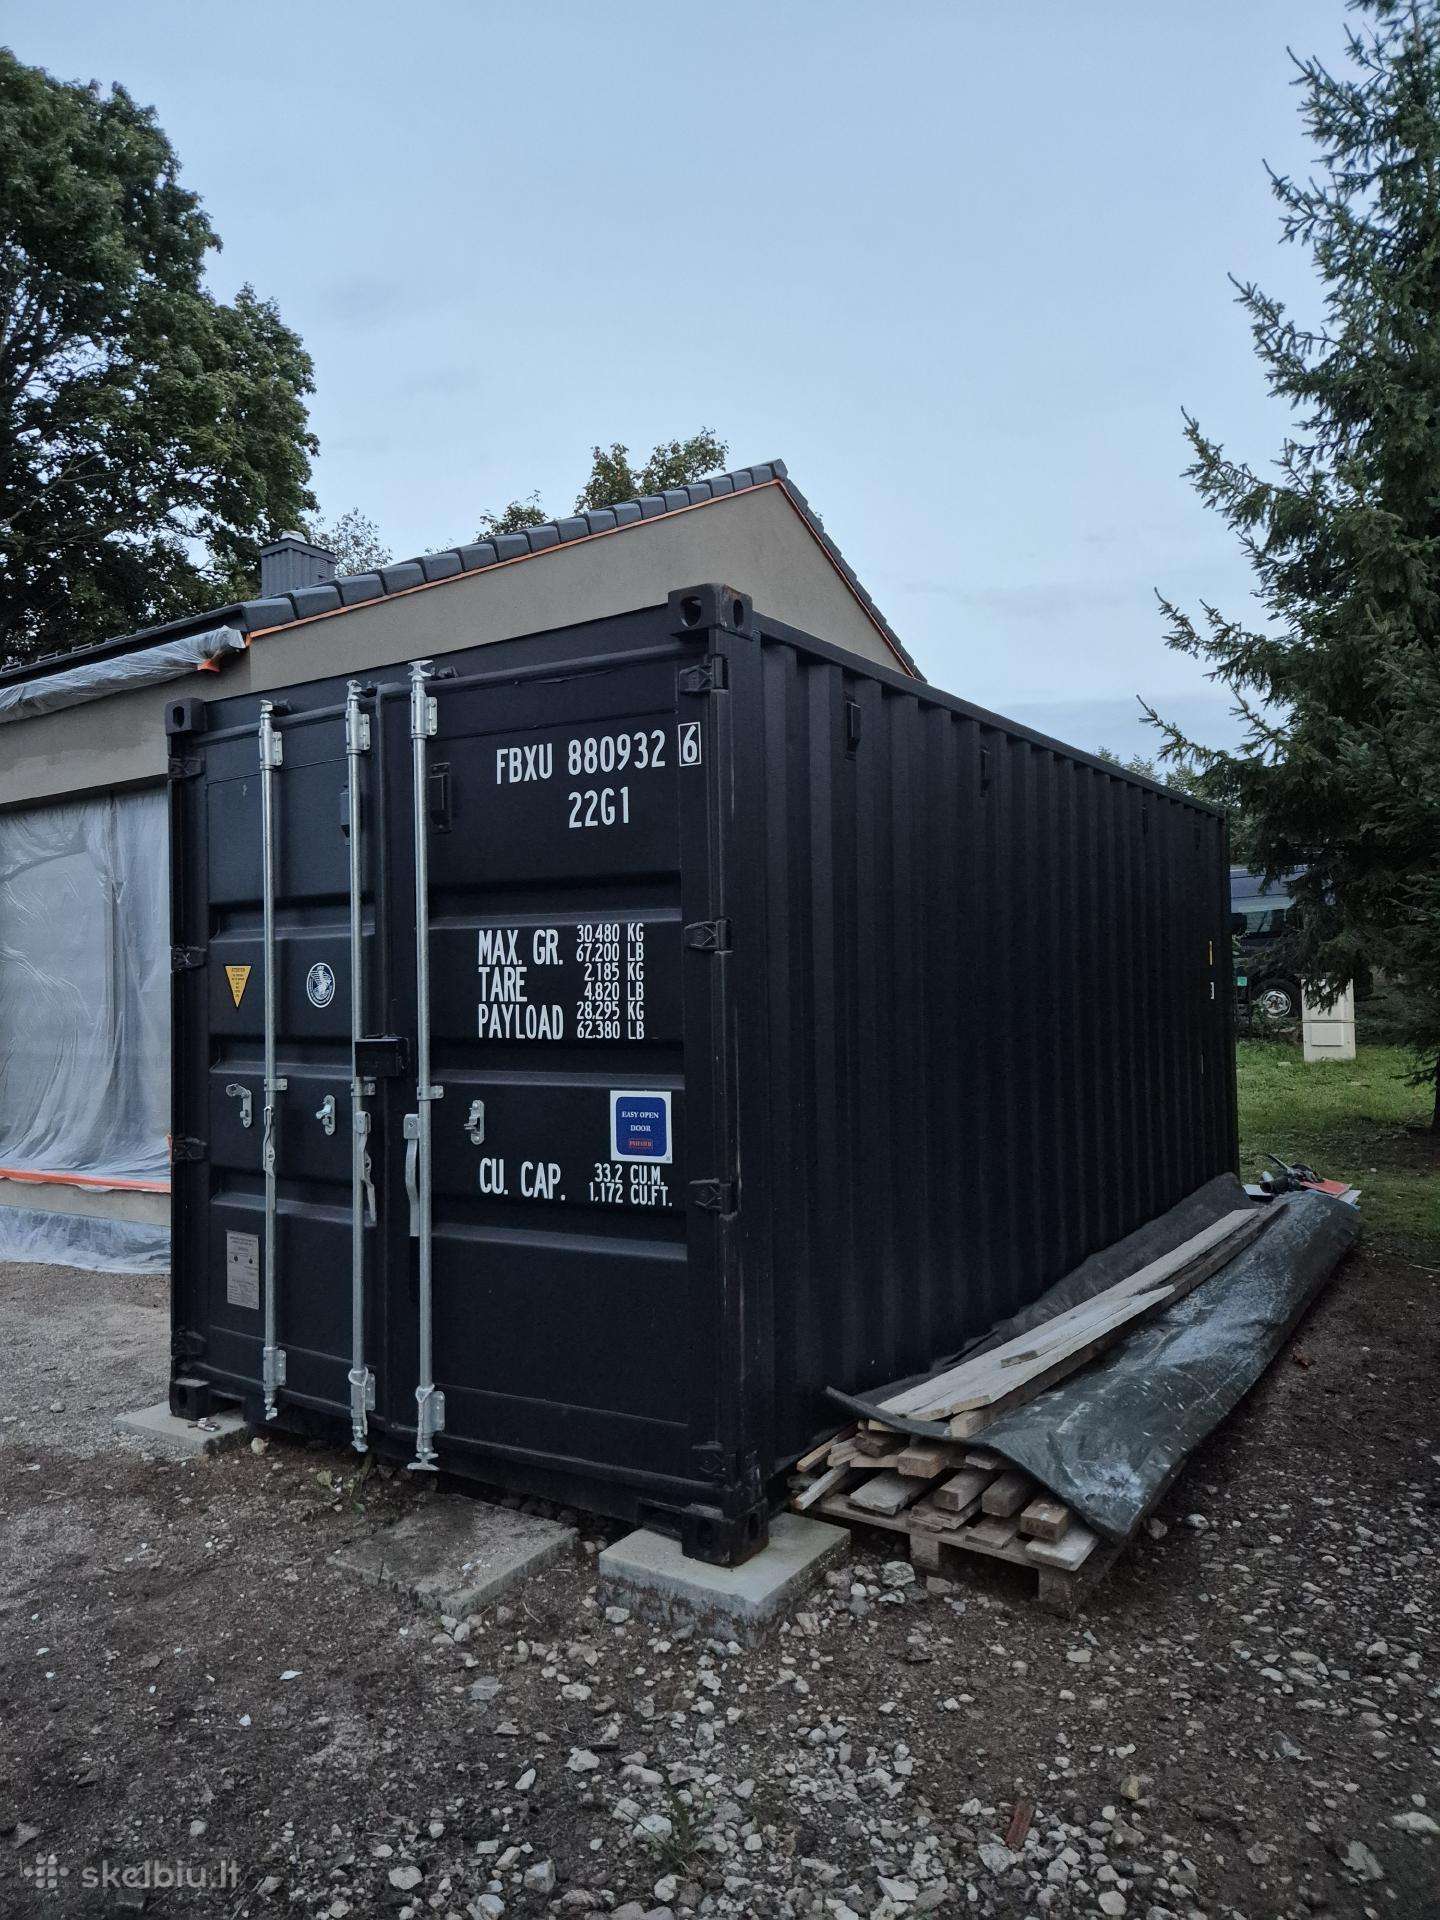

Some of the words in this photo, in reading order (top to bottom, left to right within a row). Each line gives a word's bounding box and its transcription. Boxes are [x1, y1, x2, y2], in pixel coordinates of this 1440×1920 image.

[496, 742, 553, 784] FBXU
[567, 729, 666, 776] 880932
[682, 725, 698, 763] 6
[568, 786, 629, 828] 22G1
[478, 929, 523, 966] MAX.
[533, 929, 564, 965] GR.
[627, 922, 644, 942] KG
[627, 943, 644, 962] LB
[478, 966, 527, 1002] TARE
[627, 962, 645, 981] KG
[627, 982, 645, 1001] LB
[478, 1003, 564, 1040] PAYLOAD
[627, 1001, 645, 1021] KG
[627, 1021, 645, 1040] LB
[621, 1110, 639, 1119] EASY
[639, 1111, 660, 1119] OPEN
[630, 1124, 652, 1132] DOOR
[479, 1157, 509, 1195] CU.
[520, 1161, 566, 1201] CAP.
[594, 1162, 623, 1184] 33.2
[629, 1164, 665, 1186] CU.M.
[630, 1184, 673, 1207] CU.FT.
